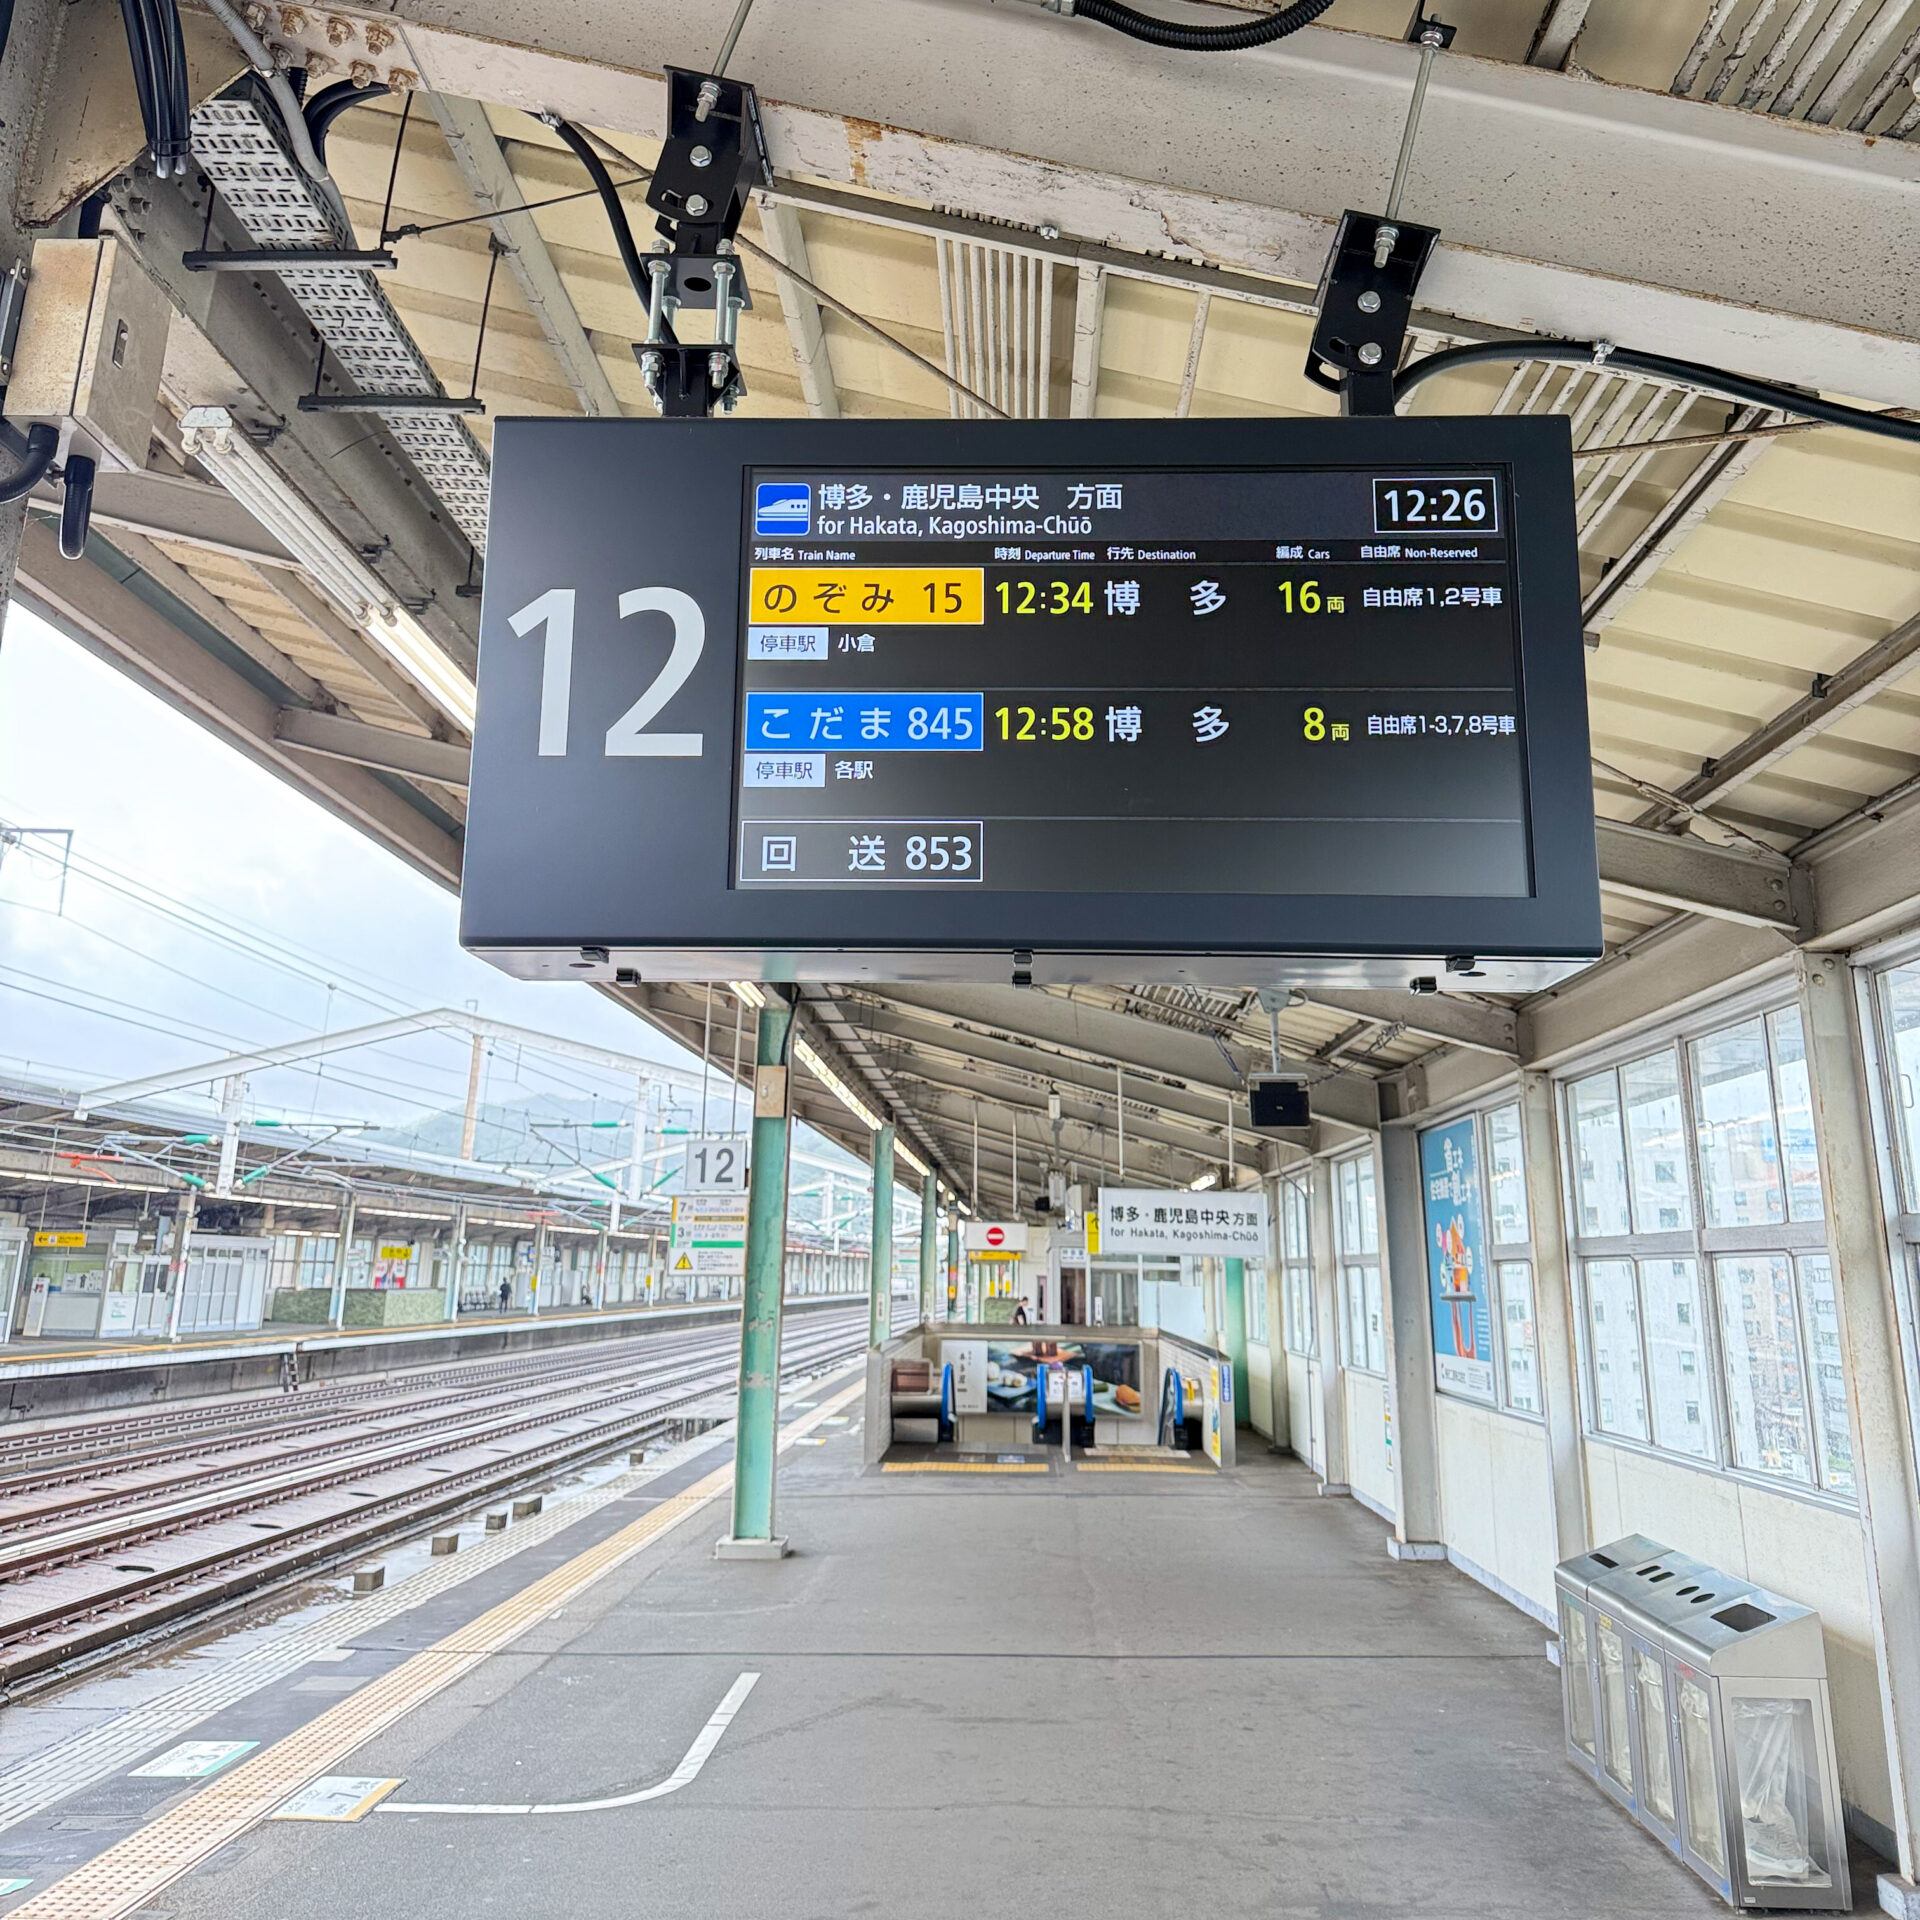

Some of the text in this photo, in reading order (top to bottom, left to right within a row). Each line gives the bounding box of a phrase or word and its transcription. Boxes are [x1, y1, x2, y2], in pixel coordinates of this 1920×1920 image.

[1066, 483, 1123, 510] 方面
[1384, 488, 1486, 522] 12:26
[816, 514, 1092, 540] for Hakata, Kagoshima-Chūō
[754, 546, 795, 561] 列車名
[797, 549, 856, 561] Train Name
[994, 546, 1022, 561] 時刻
[1024, 549, 1096, 563] Departure Time
[1106, 546, 1135, 560] 行先
[1137, 549, 1196, 560] Destination
[1275, 545, 1304, 559] 編成
[1307, 548, 1331, 560] Cars
[1360, 544, 1401, 559] 自由席
[1404, 546, 1478, 558] Non-Reserved
[923, 582, 962, 614] 15
[995, 581, 1094, 615] 12:34
[760, 634, 816, 653] 停車駅
[837, 633, 876, 653] 小倉
[506, 586, 706, 757] 12
[907, 706, 973, 741] 845
[995, 706, 1095, 741] 12:58
[756, 761, 813, 780] 停車駅
[834, 760, 874, 780] 各駅
[905, 835, 972, 871] 853
[694, 1147, 735, 1184] 12
[679, 1202, 687, 1213] 7
[677, 1227, 685, 1238] 3
[1110, 1227, 1125, 1238] for
[1130, 1227, 1168, 1240] Hakata,
